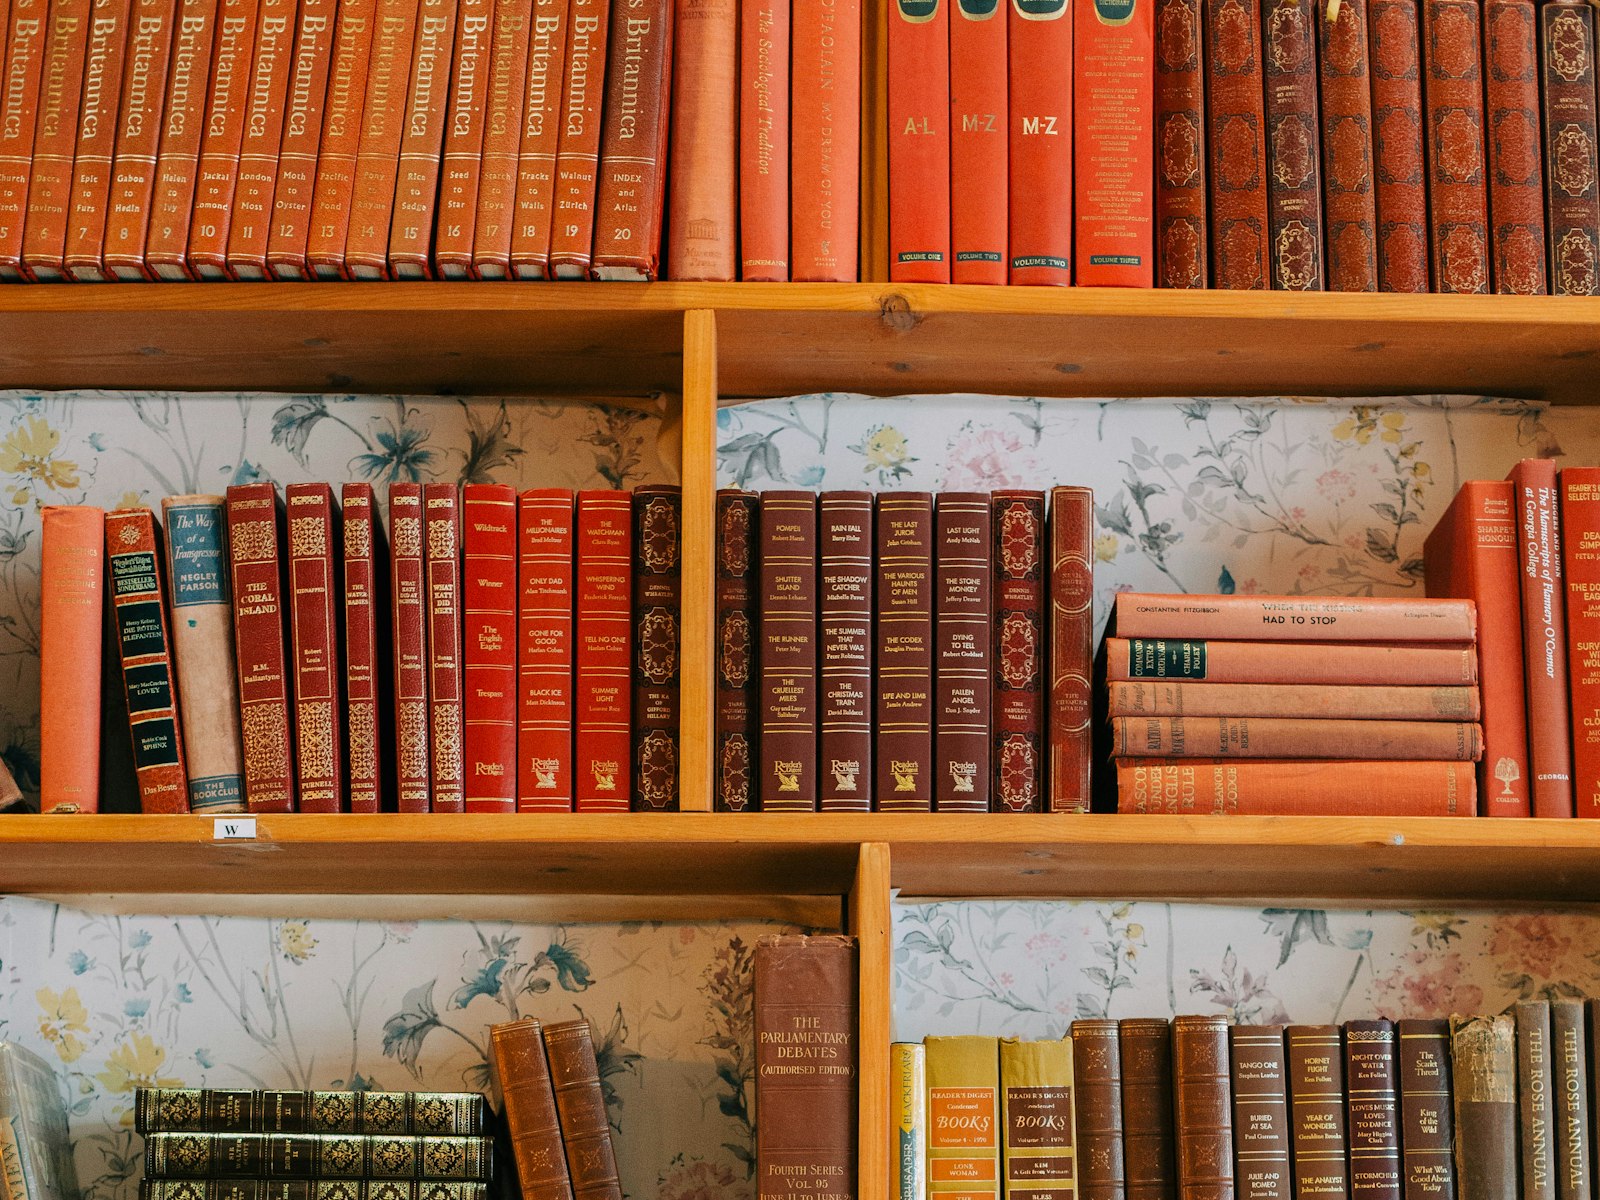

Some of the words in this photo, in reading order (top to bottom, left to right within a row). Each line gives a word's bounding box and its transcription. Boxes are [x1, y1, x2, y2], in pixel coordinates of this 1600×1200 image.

[760, 10, 772, 33] The
[82, 17, 116, 140] Britannica
[249, 16, 287, 137] Britannica
[527, 15, 559, 138] Britannica
[620, 17, 650, 140] Britannica
[754, 39, 773, 112] Sociological
[903, 116, 935, 134] A-L
[1023, 117, 1058, 135] M-Z
[759, 117, 774, 175] Tradition
[80, 174, 98, 183] Epic
[240, 173, 271, 182] London
[284, 171, 305, 180] Moth
[521, 173, 548, 181] Tracks
[613, 174, 641, 182] INDEX
[77, 204, 95, 212] Furs
[241, 202, 262, 210] Moss
[276, 201, 305, 210] Oyster
[80, 227, 87, 239] 7
[120, 228, 128, 239] 8
[201, 225, 215, 237] 10
[243, 226, 252, 238] 11
[280, 225, 294, 237] 12
[448, 226, 460, 237] 16
[522, 226, 535, 237] 18
[614, 228, 631, 240] 20
[1525, 487, 1532, 497] at
[1538, 487, 1548, 508] The
[177, 514, 193, 529] The
[196, 515, 214, 530] Way
[1525, 500, 1536, 539] Georgia
[474, 523, 507, 532] Wildtrack
[187, 534, 196, 544] of
[1540, 510, 1550, 564] Manuscripts
[1526, 542, 1538, 578] College
[181, 573, 216, 582] NEGLEY
[1543, 568, 1550, 580] of
[180, 582, 218, 591] FARSON
[246, 583, 267, 592] THE
[478, 579, 503, 587] Winner
[241, 594, 274, 604] CORAL
[1544, 582, 1554, 625] Flannery
[239, 605, 276, 615] ISLAND
[1263, 616, 1287, 625] HAD
[1310, 617, 1336, 625] STOP
[479, 634, 502, 643] English
[1545, 627, 1556, 678] O'Connor
[194, 789, 216, 800] BOOK
[219, 787, 238, 797] CLUB
[225, 825, 238, 835] W
[793, 1017, 820, 1028] THE
[761, 1032, 851, 1044] PARLIAMENTARY
[1530, 1028, 1542, 1060] THE
[777, 1046, 837, 1058] DEBATES
[761, 1064, 815, 1077] (AUTHORISED
[819, 1064, 855, 1077] EDITION)
[1531, 1065, 1544, 1111] ROSE
[937, 1116, 990, 1130] BOOKS
[1533, 1118, 1547, 1190] ANNUAL
[769, 1165, 806, 1176] FOURTH
[811, 1165, 844, 1175] SERIES
